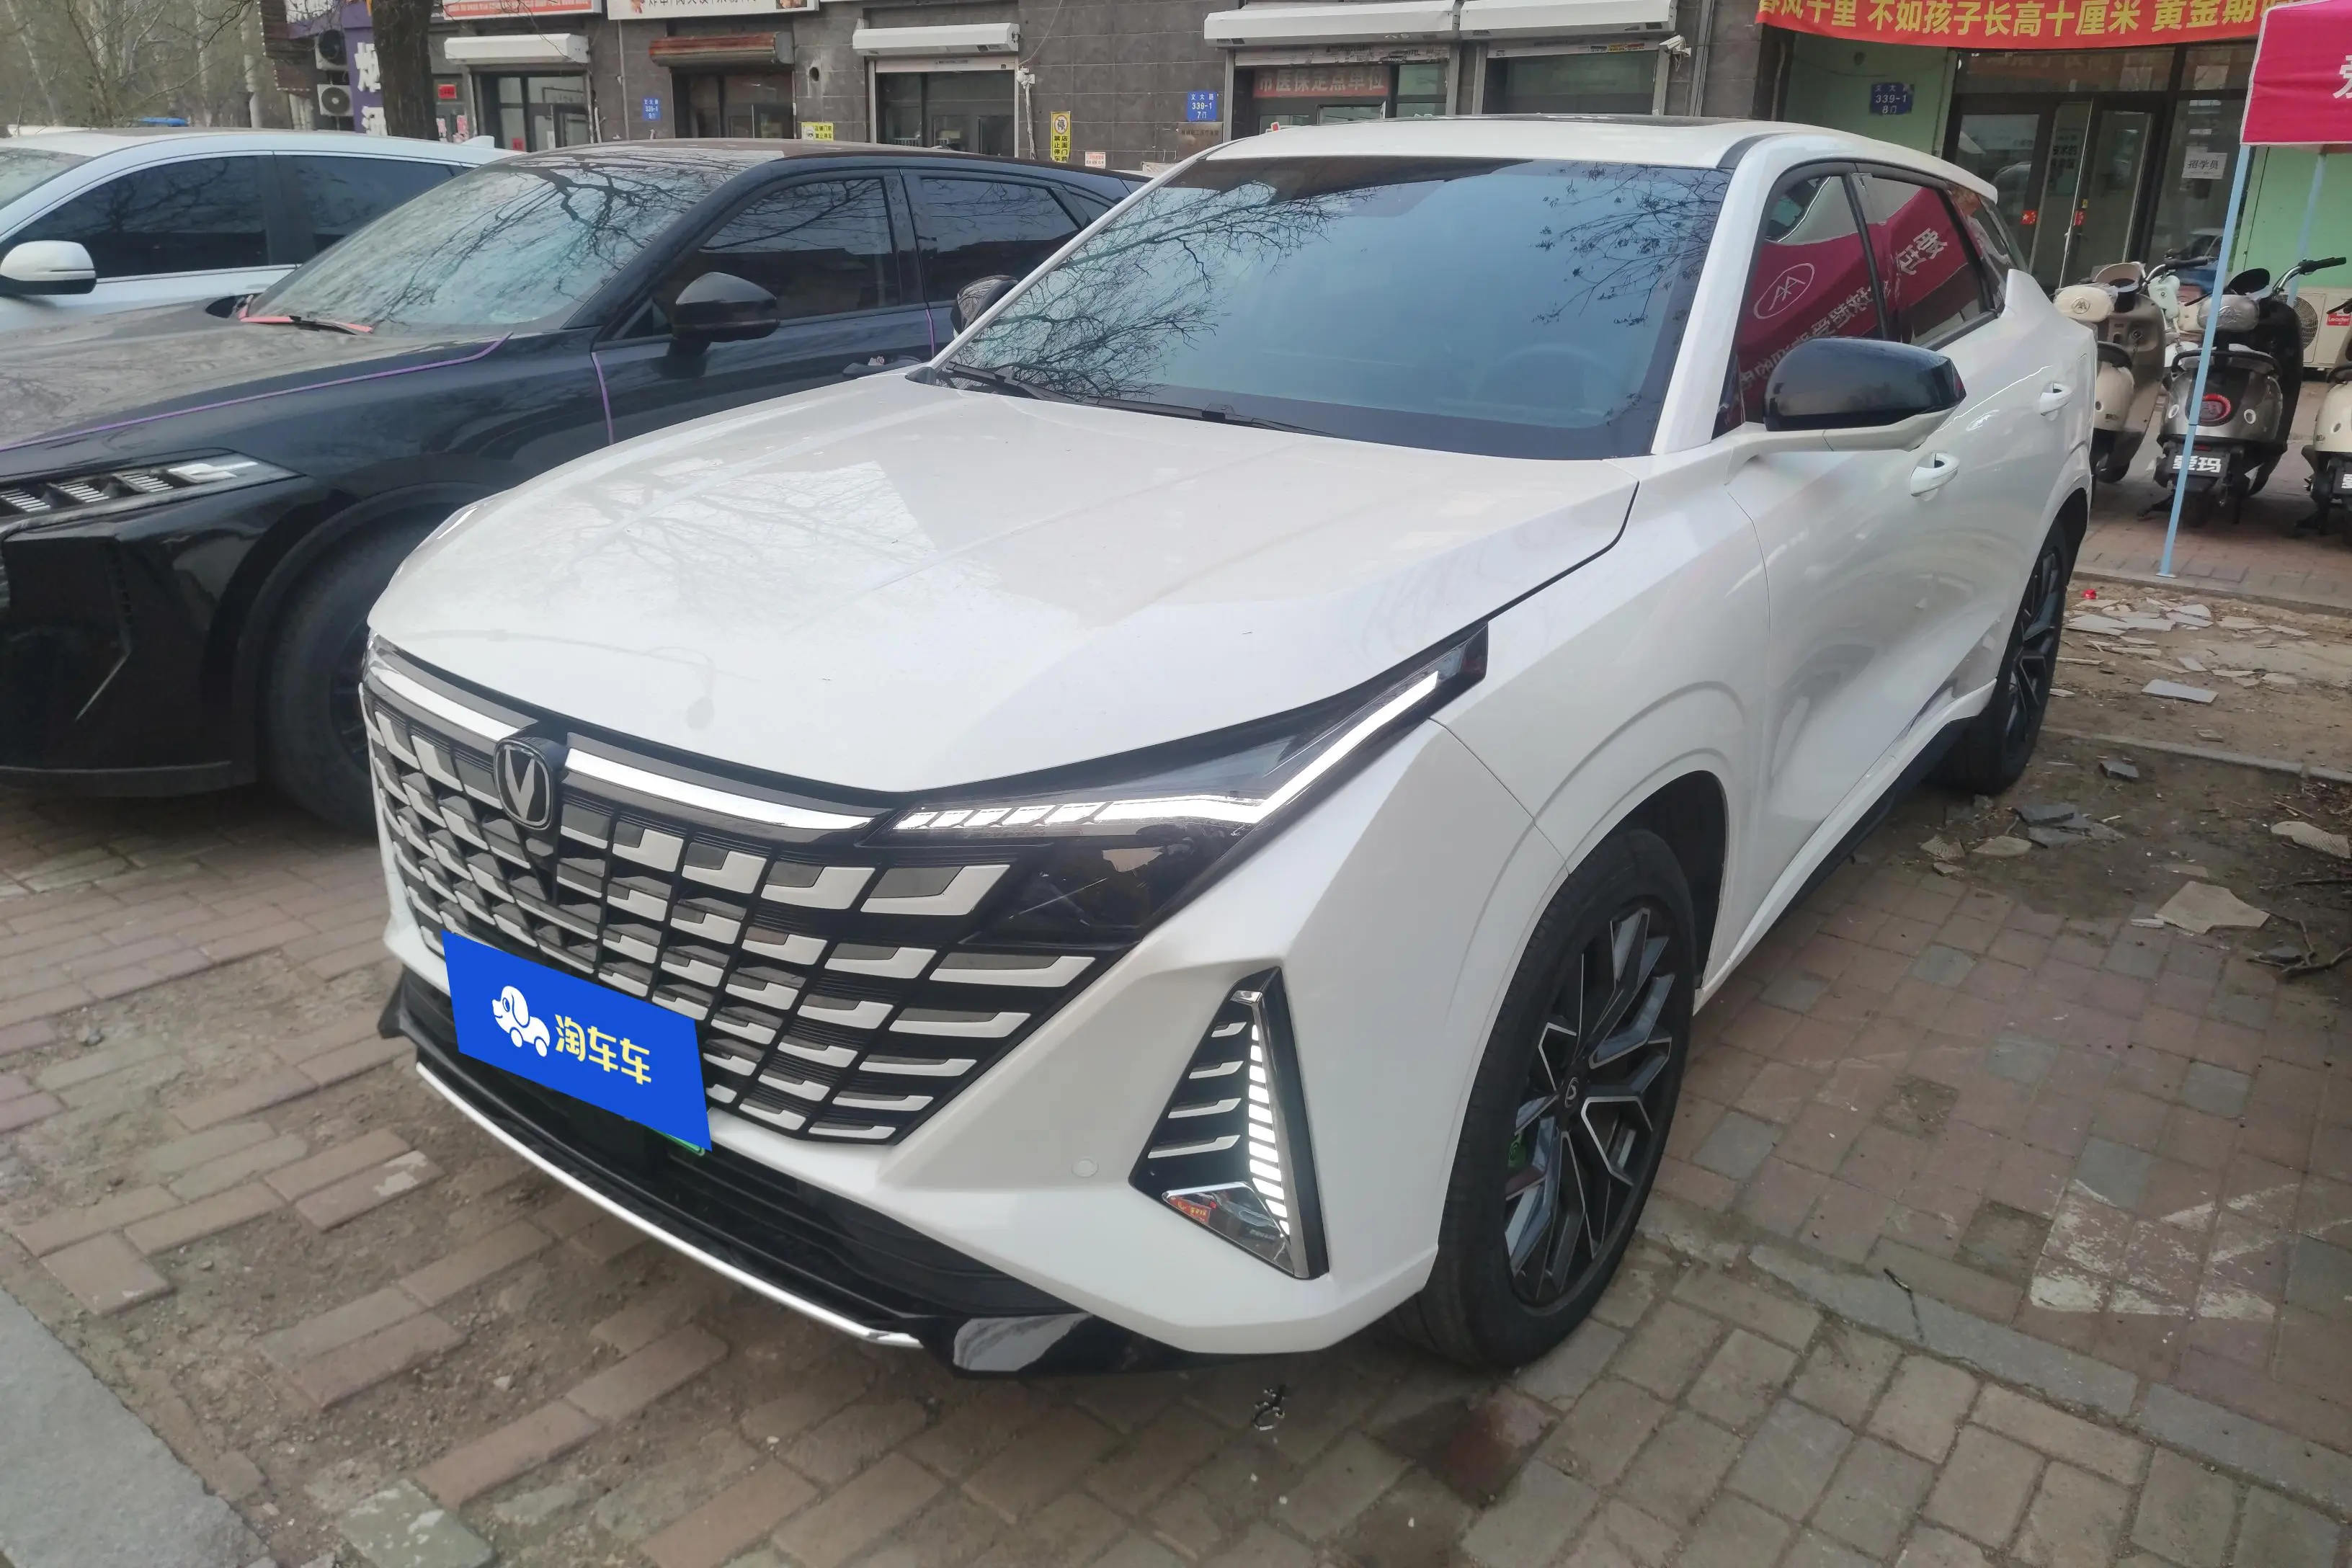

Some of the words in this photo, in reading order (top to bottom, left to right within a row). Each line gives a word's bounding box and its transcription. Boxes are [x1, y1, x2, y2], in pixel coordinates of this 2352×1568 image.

[1868, 0, 2142, 36] 不如孩子长高十厘米
[1875, 94, 1907, 104] 339-1
[2188, 160, 2218, 170] 招学员
